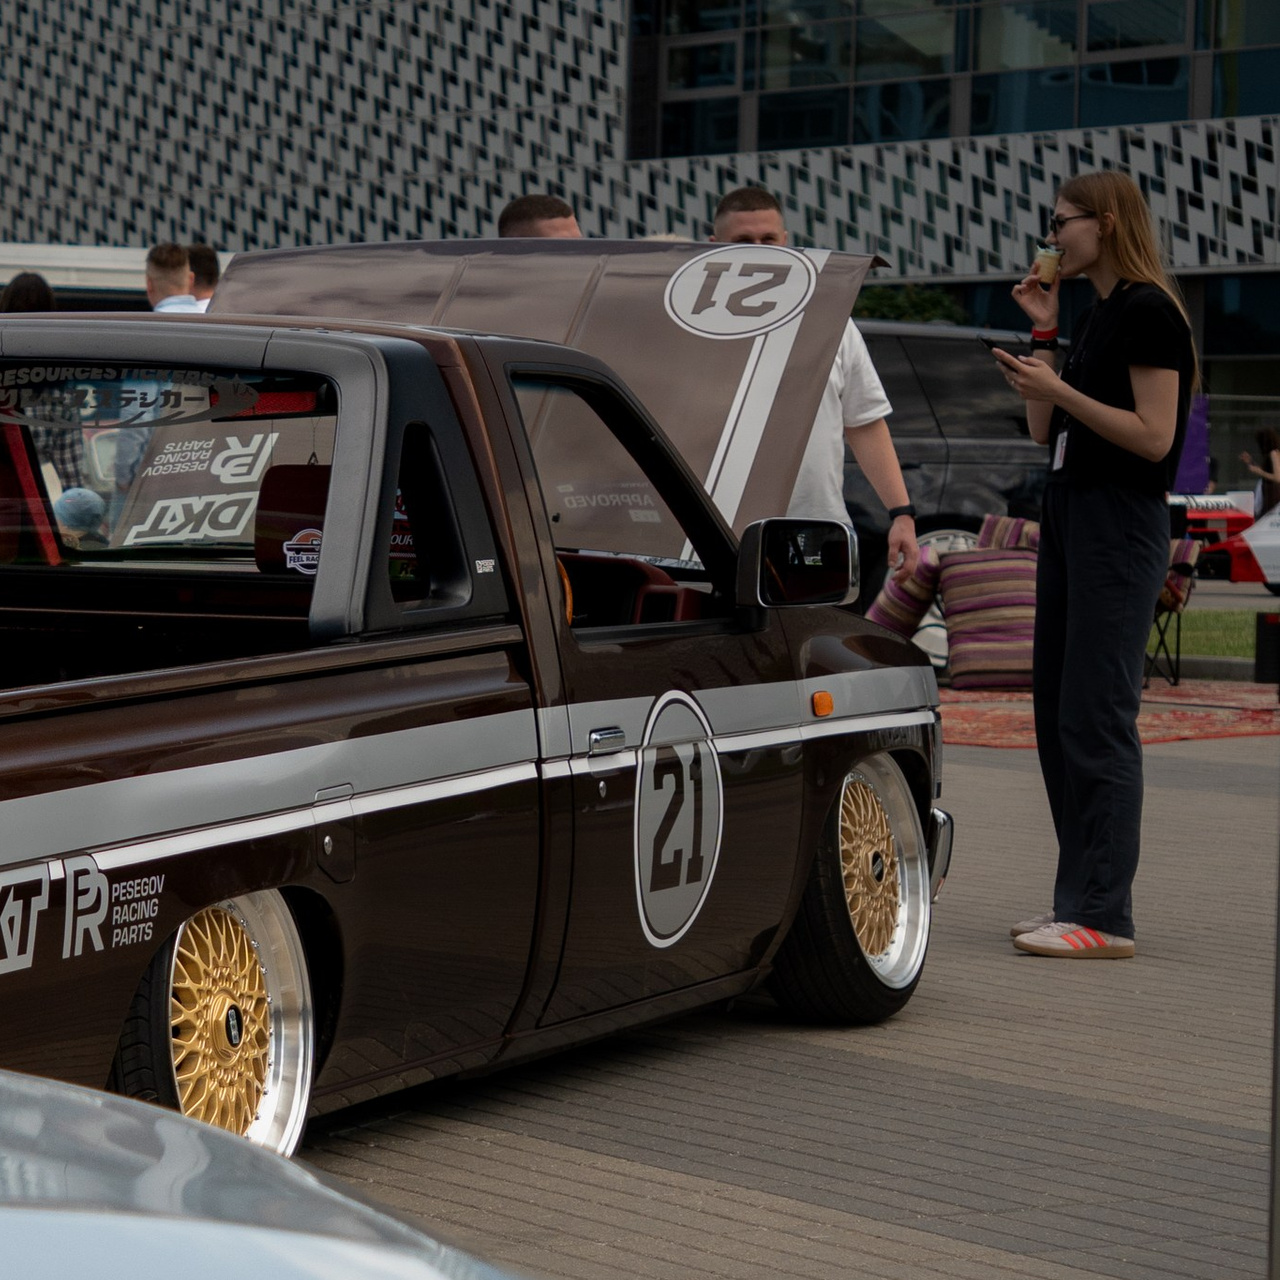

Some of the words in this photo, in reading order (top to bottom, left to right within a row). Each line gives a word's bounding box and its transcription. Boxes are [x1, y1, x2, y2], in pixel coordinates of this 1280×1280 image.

[691, 261, 793, 318] 21
[153, 449, 213, 465] RACING
[163, 438, 215, 453] PARTS
[141, 460, 210, 477] PESEGOV
[123, 491, 260, 546] DKT
[650, 742, 704, 892] 21
[111, 874, 165, 900] PESEGOV
[111, 899, 160, 926] RACING
[111, 922, 154, 949] PARTS
